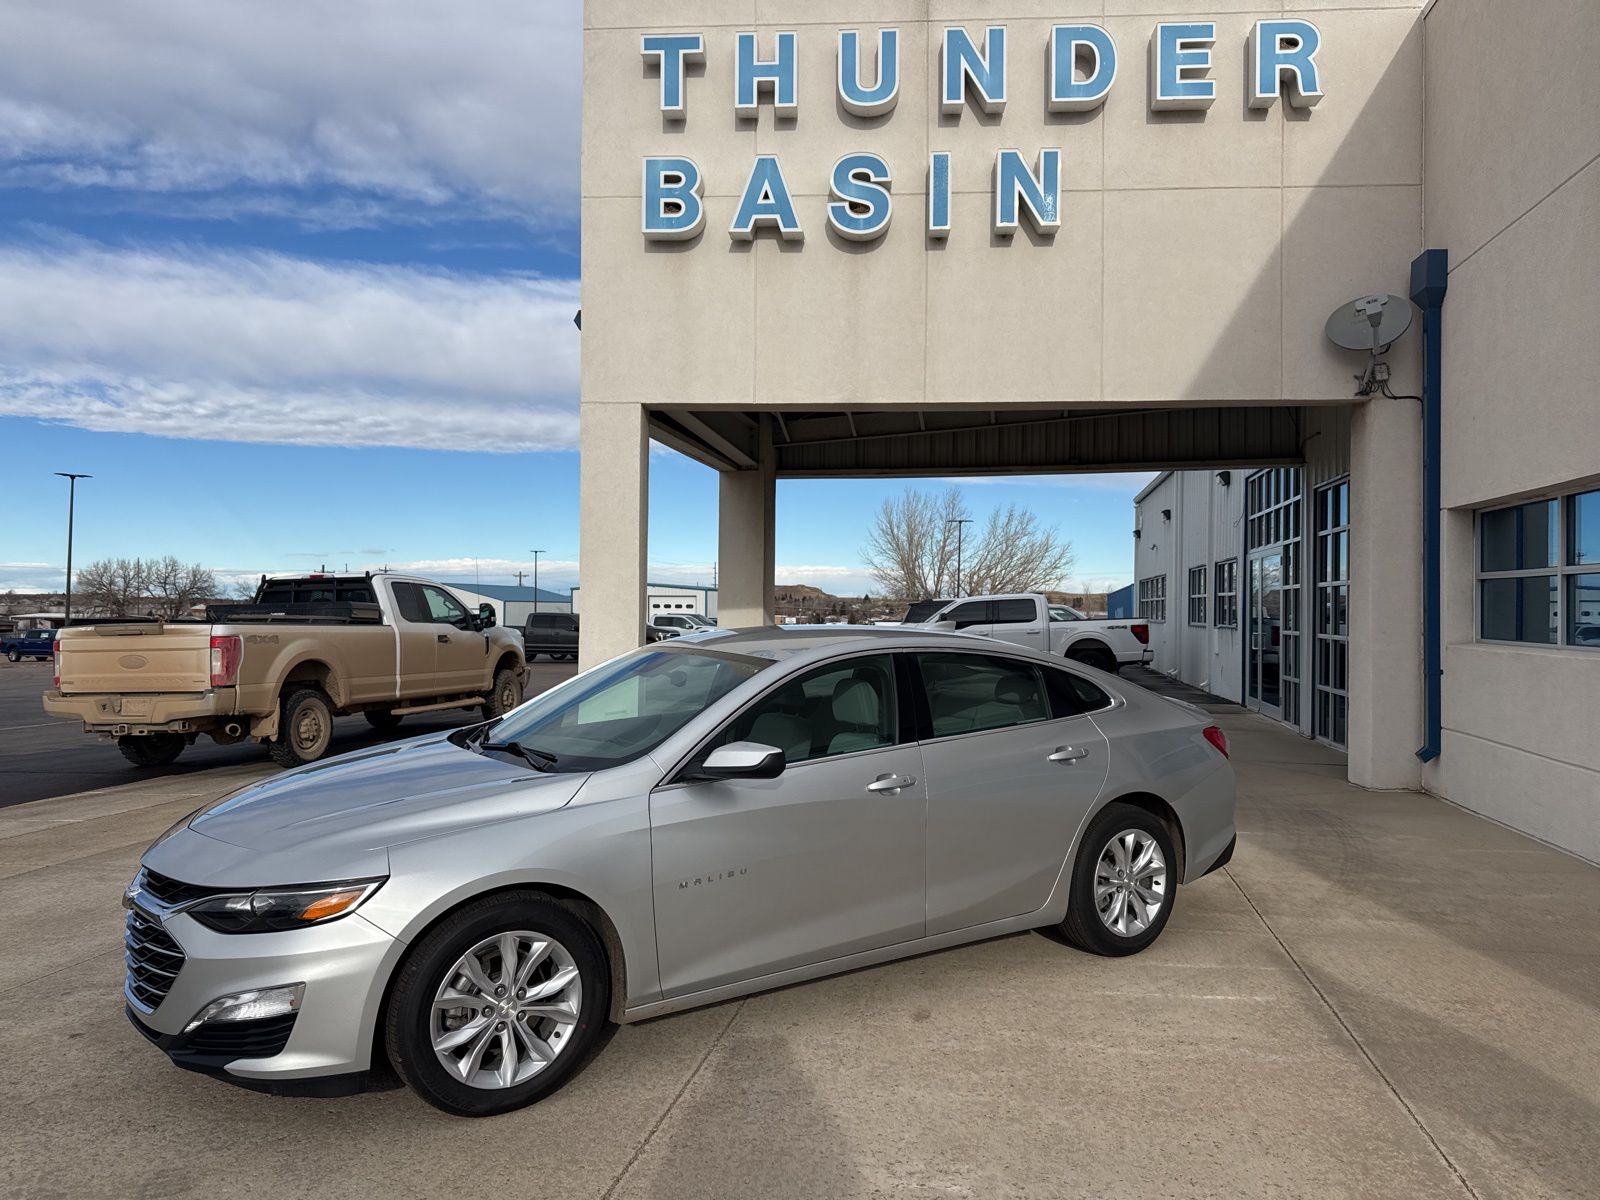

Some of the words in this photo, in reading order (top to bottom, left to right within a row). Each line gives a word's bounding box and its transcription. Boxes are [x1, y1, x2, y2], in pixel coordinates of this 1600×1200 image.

[641, 19, 1324, 119] THUNDER
[641, 148, 1062, 241] BASIN
[679, 868, 747, 889] MALIBU
